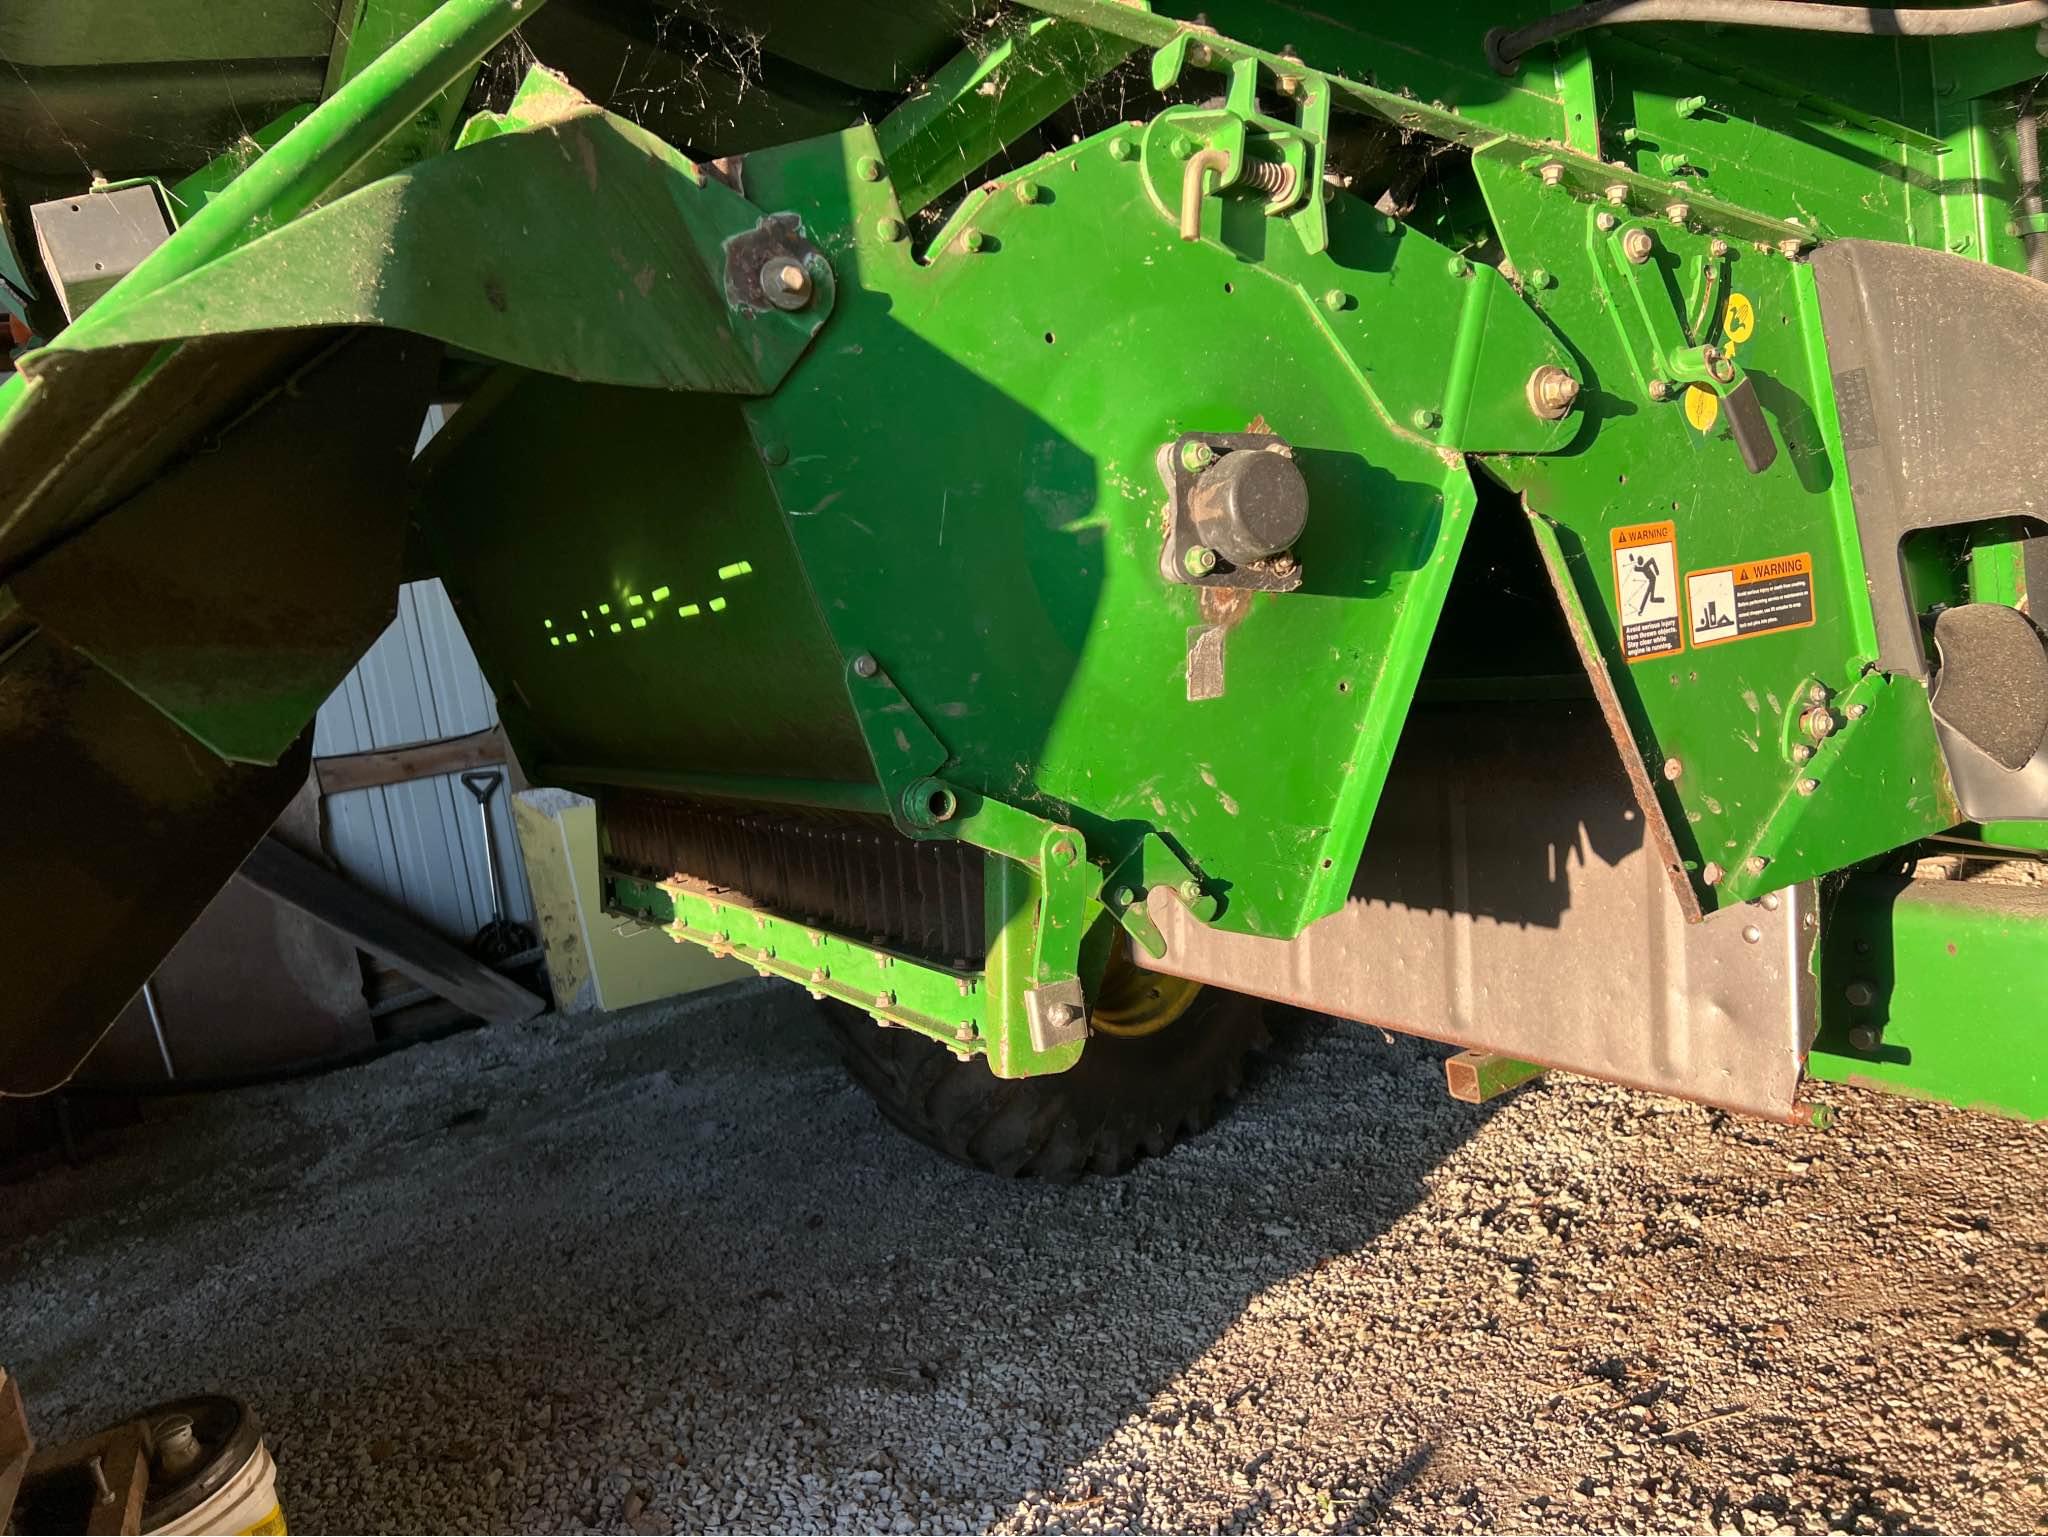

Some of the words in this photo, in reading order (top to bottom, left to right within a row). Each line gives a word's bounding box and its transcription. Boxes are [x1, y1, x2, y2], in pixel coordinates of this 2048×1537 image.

[1629, 528, 1668, 541] WARNING
[1753, 559, 1802, 577] WARNING
[1626, 626, 1641, 634] Avoid
[1641, 622, 1660, 631] serious
[1661, 620, 1675, 628] injury
[1626, 633, 1639, 641] from
[1639, 630, 1657, 639] thrown
[1657, 626, 1677, 636] objects.
[1627, 641, 1639, 649] Stay
[1628, 648, 1645, 656] engine
[1652, 642, 1672, 651] running.
